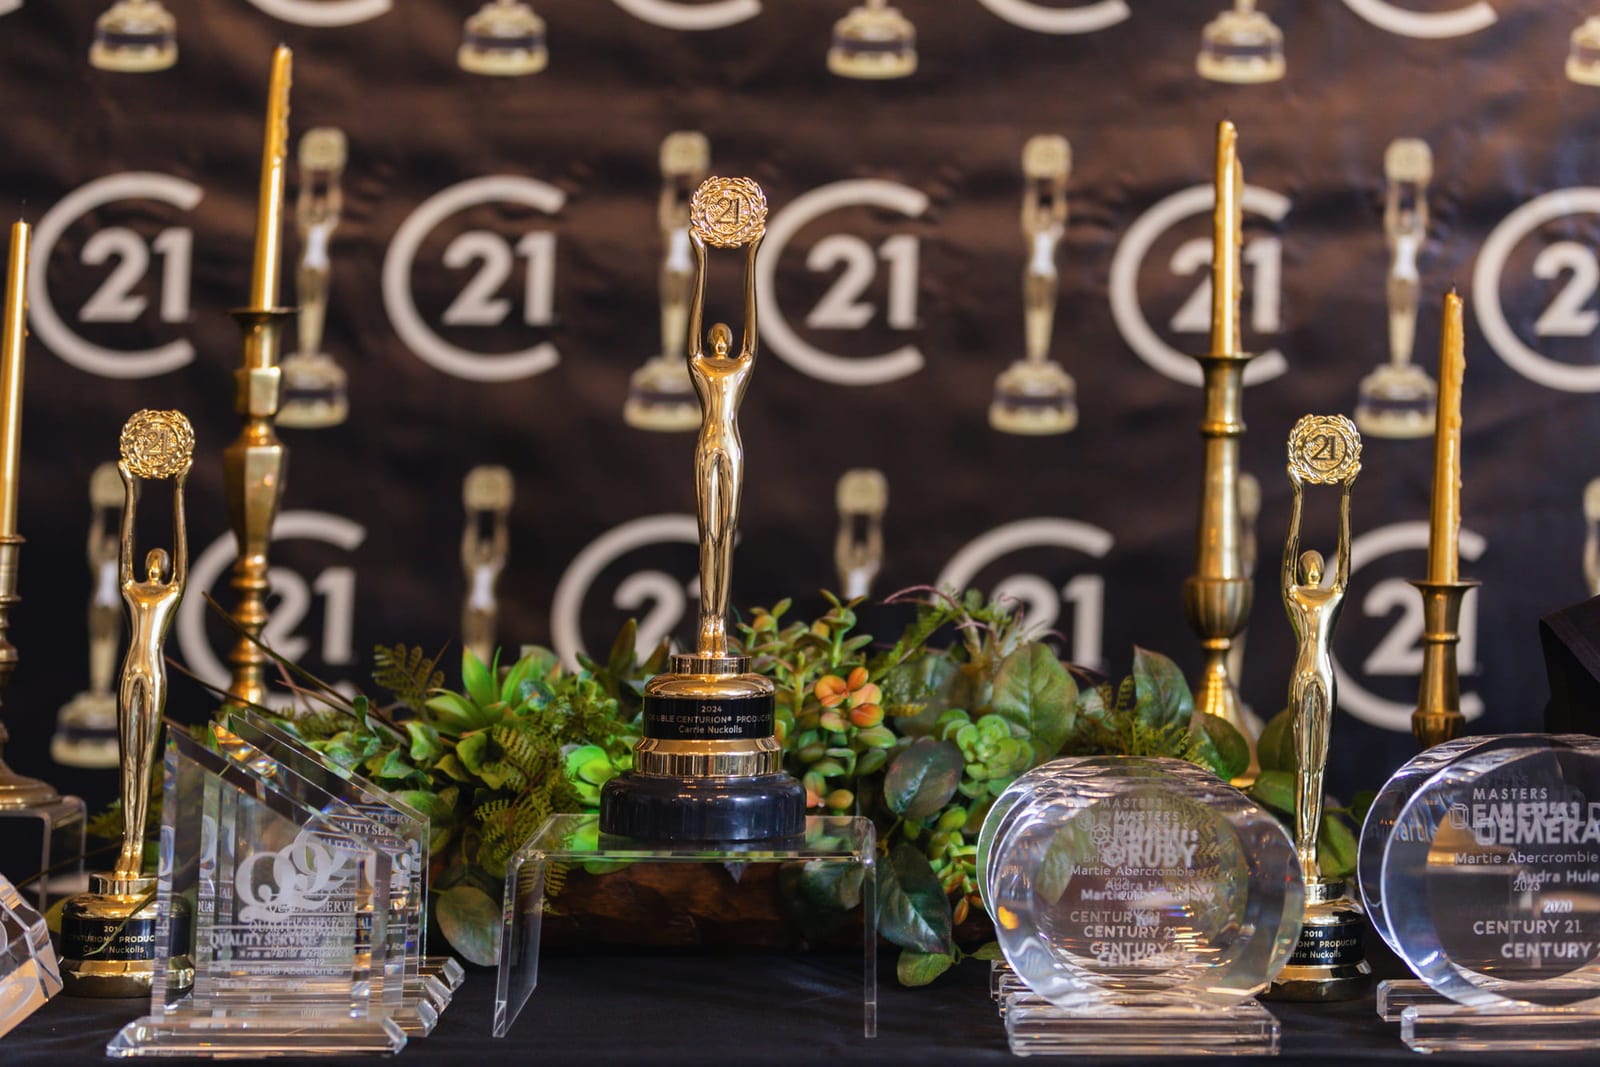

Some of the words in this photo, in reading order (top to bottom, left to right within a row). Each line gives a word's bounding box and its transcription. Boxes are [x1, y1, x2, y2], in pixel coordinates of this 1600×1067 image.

[716, 197, 740, 224] 21
[1310, 434, 1337, 461] 21
[701, 705, 722, 713] 2024
[678, 725, 705, 734] Carrie
[707, 725, 743, 734] Nuckolls
[1473, 788, 1548, 800] MASTERS
[1127, 843, 1198, 868] RUBY
[1455, 853, 1501, 864] Martie
[1507, 852, 1598, 864] Abercrombie
[1070, 865, 1111, 876] Martie
[1116, 865, 1196, 877] Abercrombie
[1517, 870, 1560, 883] Audra
[1084, 925, 1160, 938] CENTURY
[1473, 920, 1560, 935] CENTURY
[119, 935, 155, 943] PRODUC
[209, 931, 262, 949] QUALITY
[1304, 930, 1323, 938] 2018
[109, 945, 145, 953] Nuckolls
[1501, 942, 1592, 958] CENTURY
